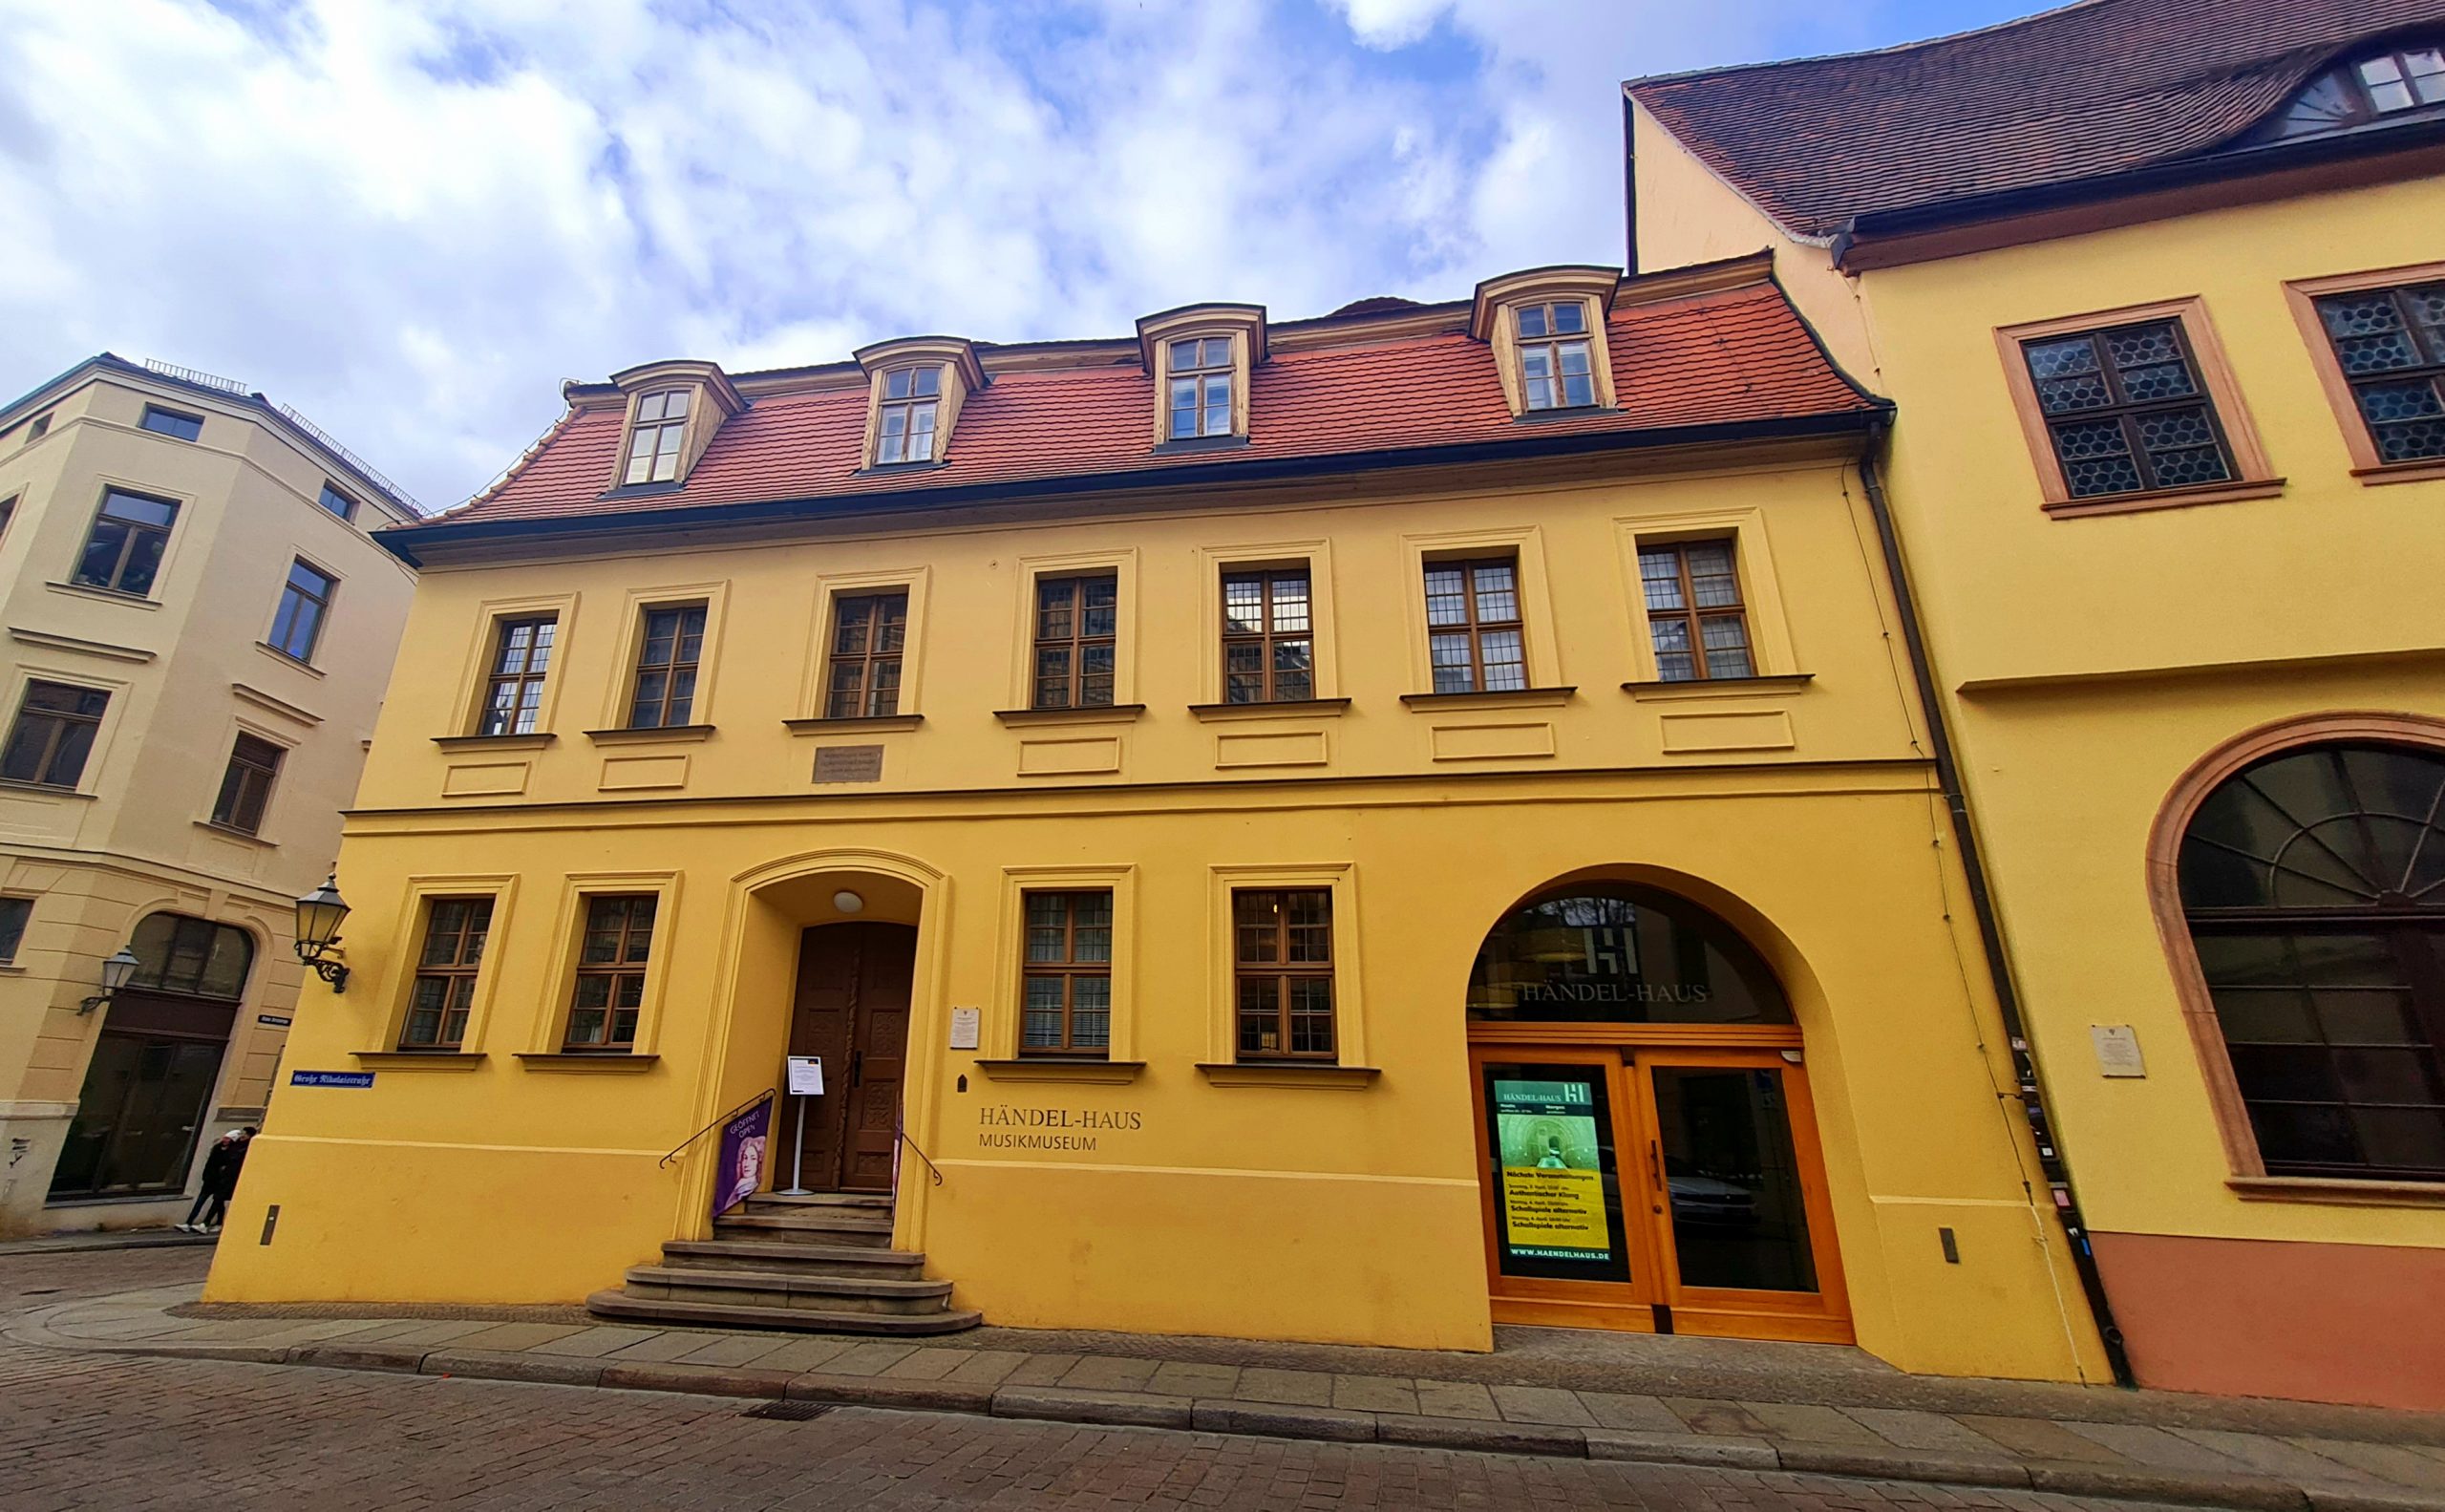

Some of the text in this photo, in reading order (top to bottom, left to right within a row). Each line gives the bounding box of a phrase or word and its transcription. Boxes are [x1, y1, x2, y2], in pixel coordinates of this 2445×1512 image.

[1523, 979, 1706, 1003] HÄNDEL-HAUS
[1503, 1093, 1562, 1102] HÄNDEL-HAUS
[730, 1110, 760, 1135] GEÖFFNET
[980, 1104, 1141, 1130] HÄNDEL-HAUS
[738, 1124, 755, 1138] OPEN
[979, 1134, 1096, 1151] MUSIKMUSEUM
[1511, 1248, 1609, 1260] WWW.HAENDELHAUS.DE
